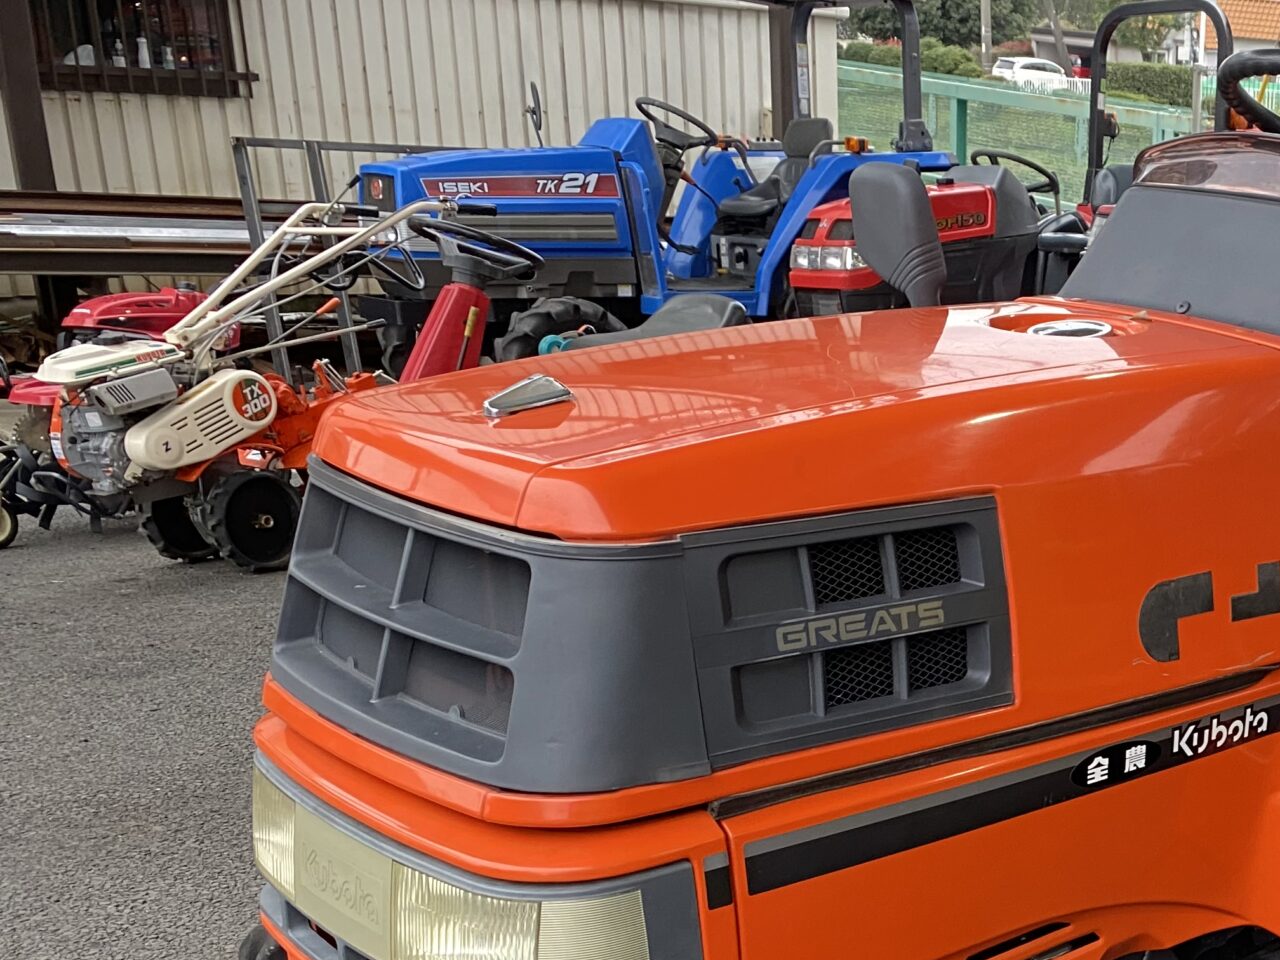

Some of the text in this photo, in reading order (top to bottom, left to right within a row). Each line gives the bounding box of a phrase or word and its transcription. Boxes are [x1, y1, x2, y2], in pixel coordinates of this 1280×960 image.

[438, 173, 599, 194] ISEKI TK21
[243, 383, 263, 400] TX
[242, 397, 271, 418] 300
[775, 600, 945, 652] GREATS
[1172, 707, 1268, 757] Kubota
